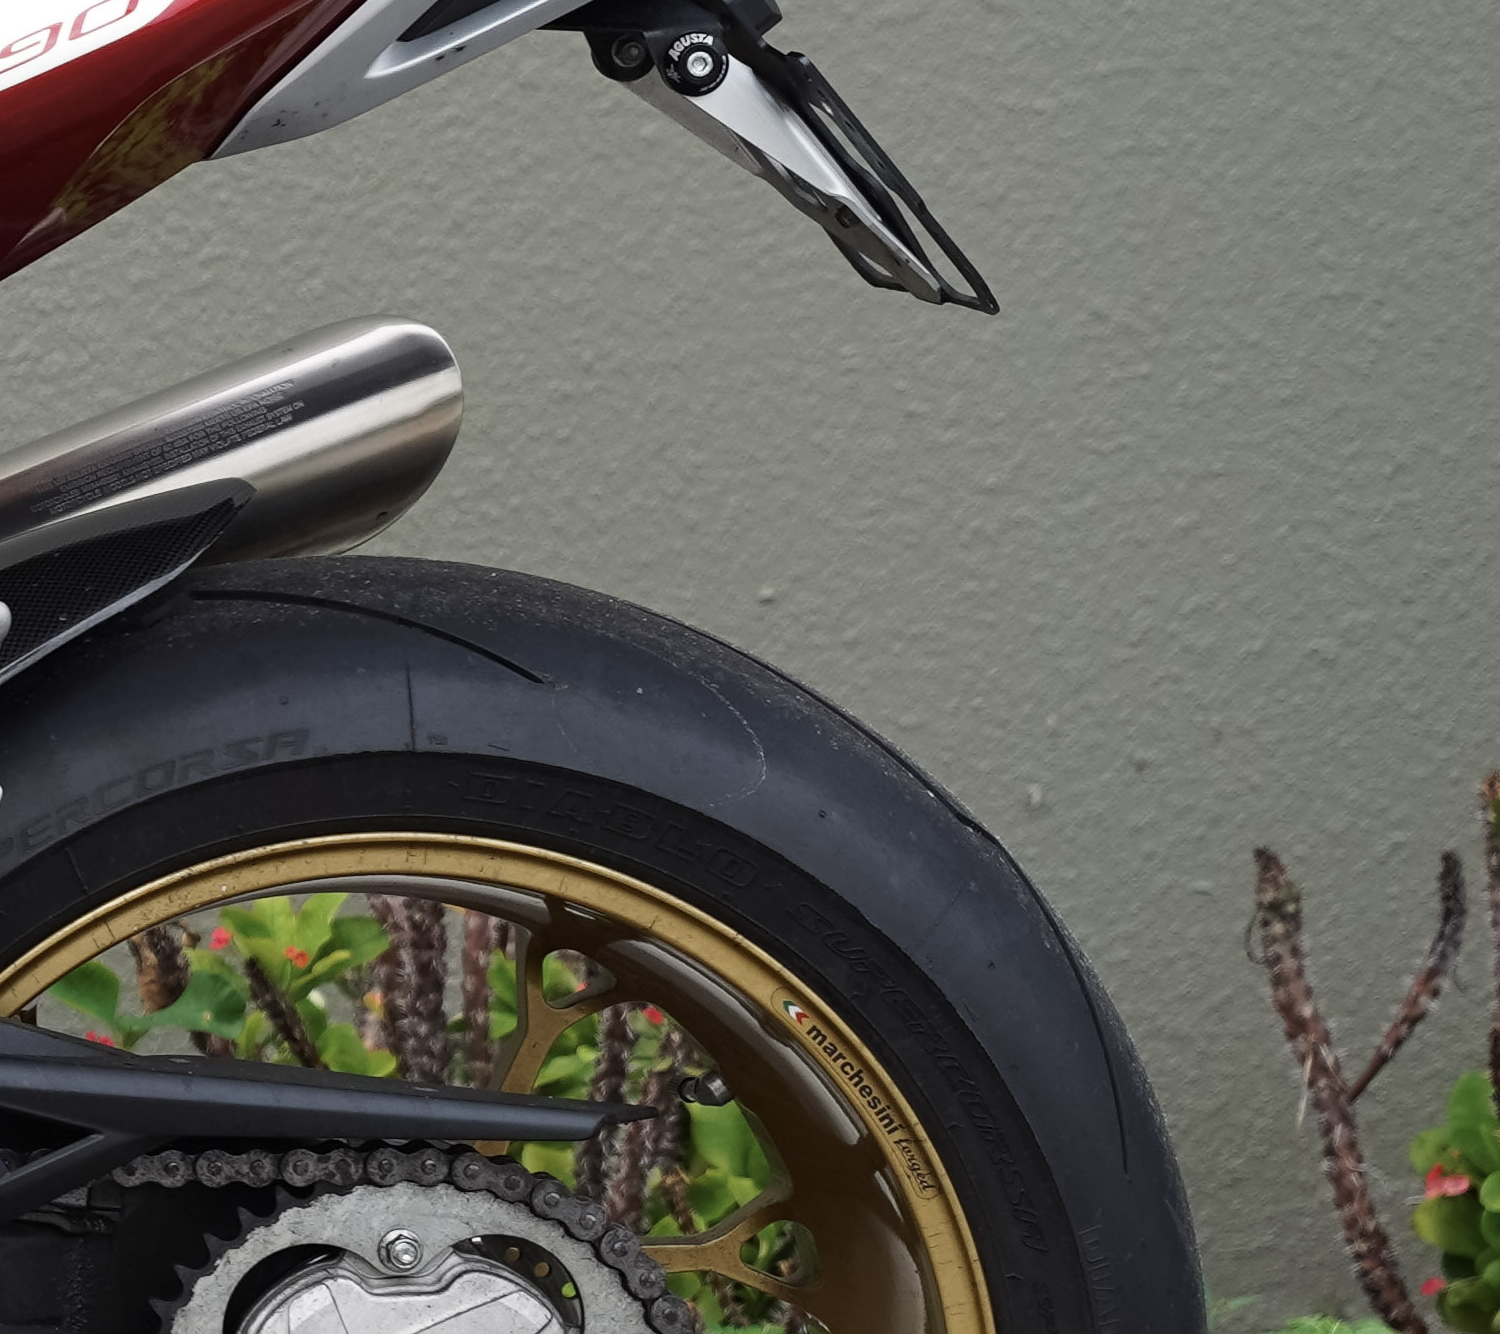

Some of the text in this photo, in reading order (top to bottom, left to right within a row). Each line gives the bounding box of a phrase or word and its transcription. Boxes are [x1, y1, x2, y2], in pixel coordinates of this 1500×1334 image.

[668, 33, 713, 61] AGUSTA
[806, 1025, 935, 1194] marchesini forged
